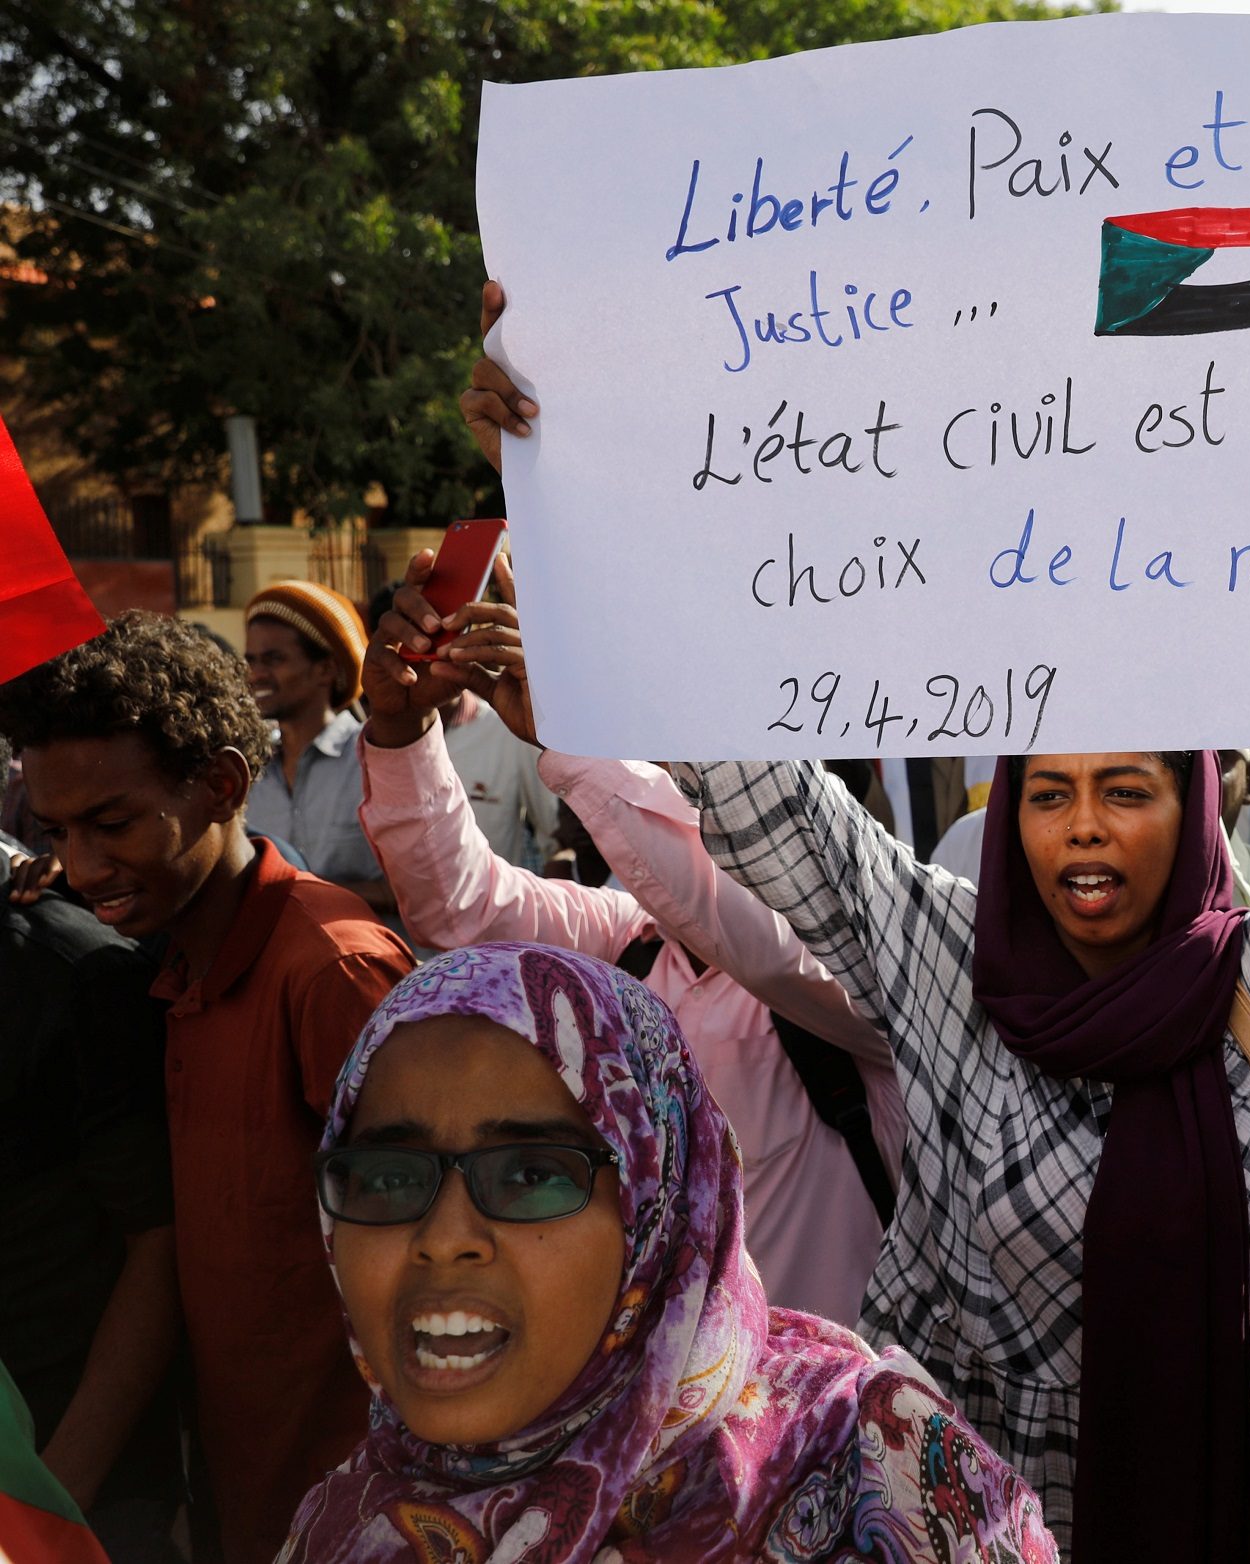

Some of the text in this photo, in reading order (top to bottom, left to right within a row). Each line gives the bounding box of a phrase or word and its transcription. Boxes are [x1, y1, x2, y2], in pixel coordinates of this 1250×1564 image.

[969, 107, 1121, 221] Paix
[1164, 90, 1248, 190] et
[704, 270, 914, 373] Justice
[692, 399, 903, 491] L'état
[1134, 360, 1226, 453] est
[751, 532, 927, 608] choix
[989, 507, 1074, 589] de
[1109, 516, 1188, 592] la
